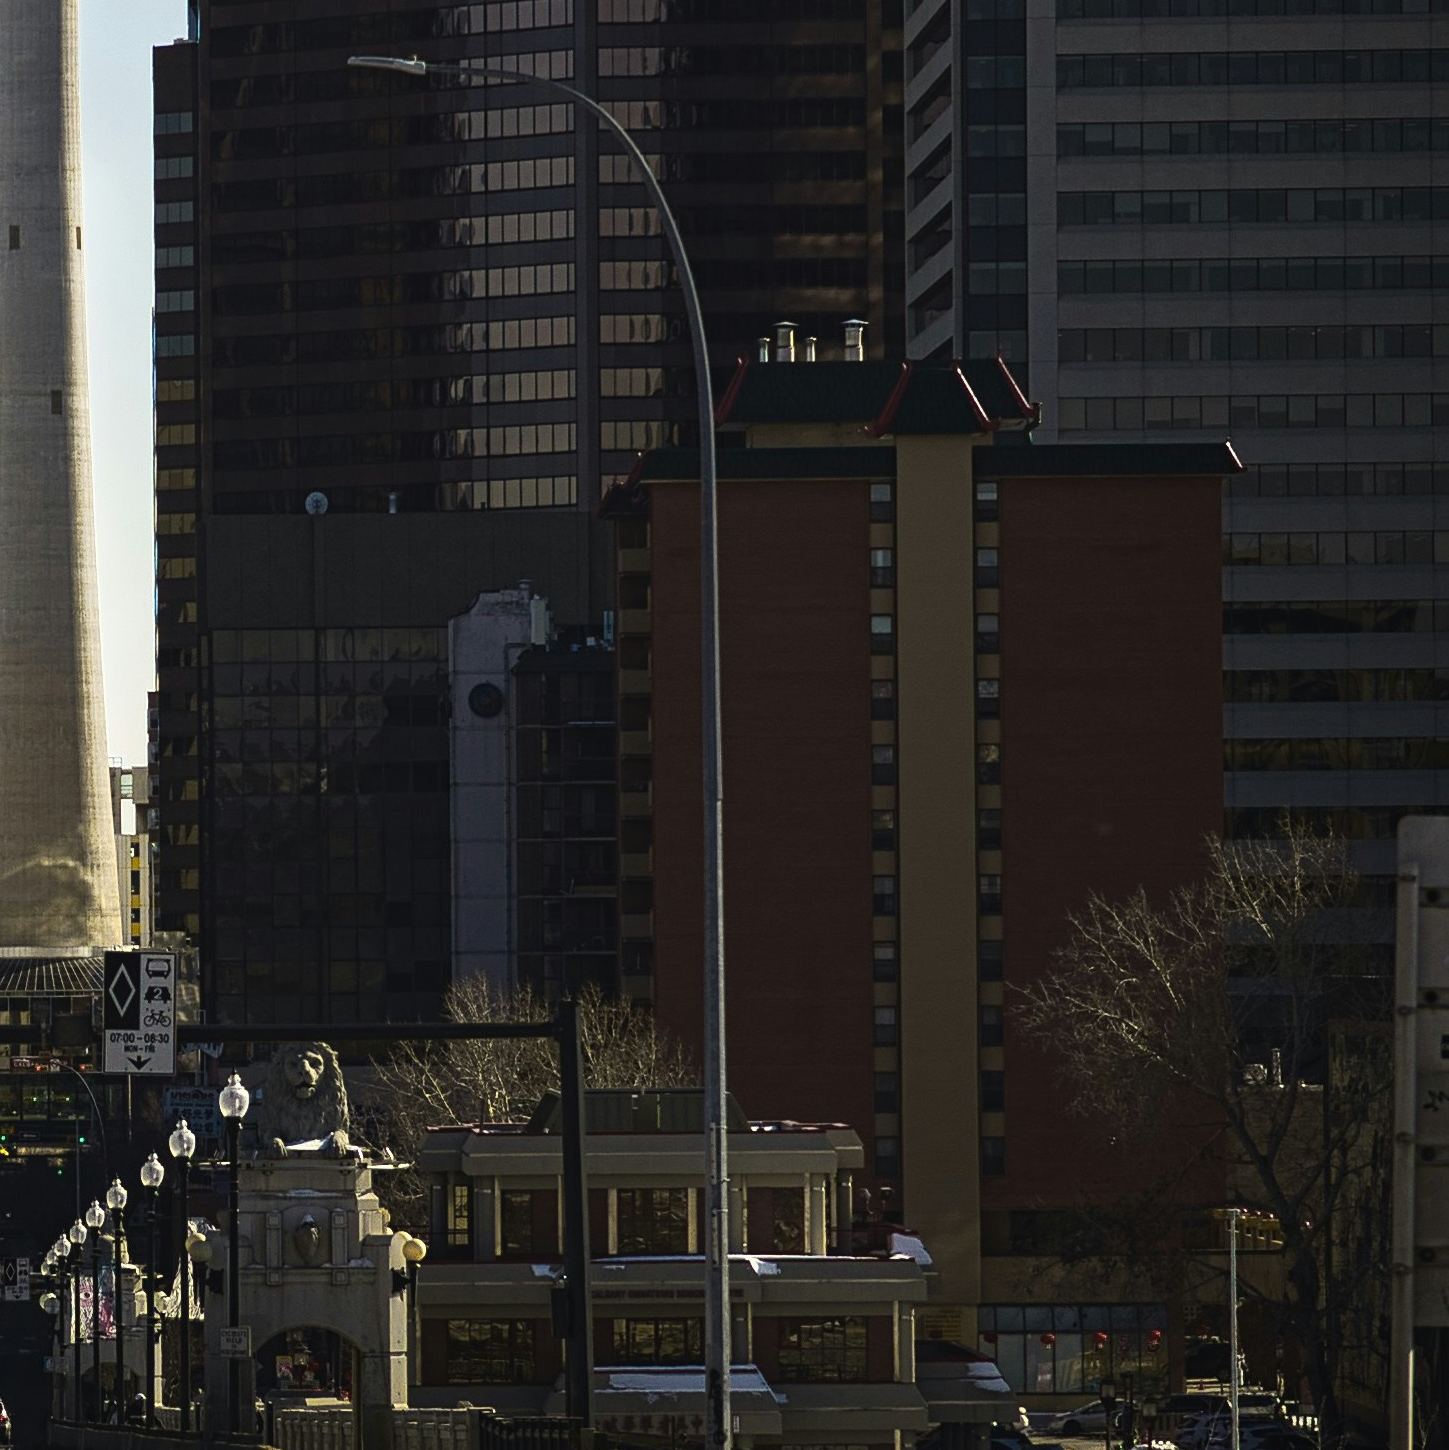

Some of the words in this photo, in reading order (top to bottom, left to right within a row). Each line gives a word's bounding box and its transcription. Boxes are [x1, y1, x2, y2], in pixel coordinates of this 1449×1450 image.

[110, 1032, 135, 1043] 07:00
[144, 1033, 170, 1044] 08:30
[144, 1045, 156, 1053] FRI
